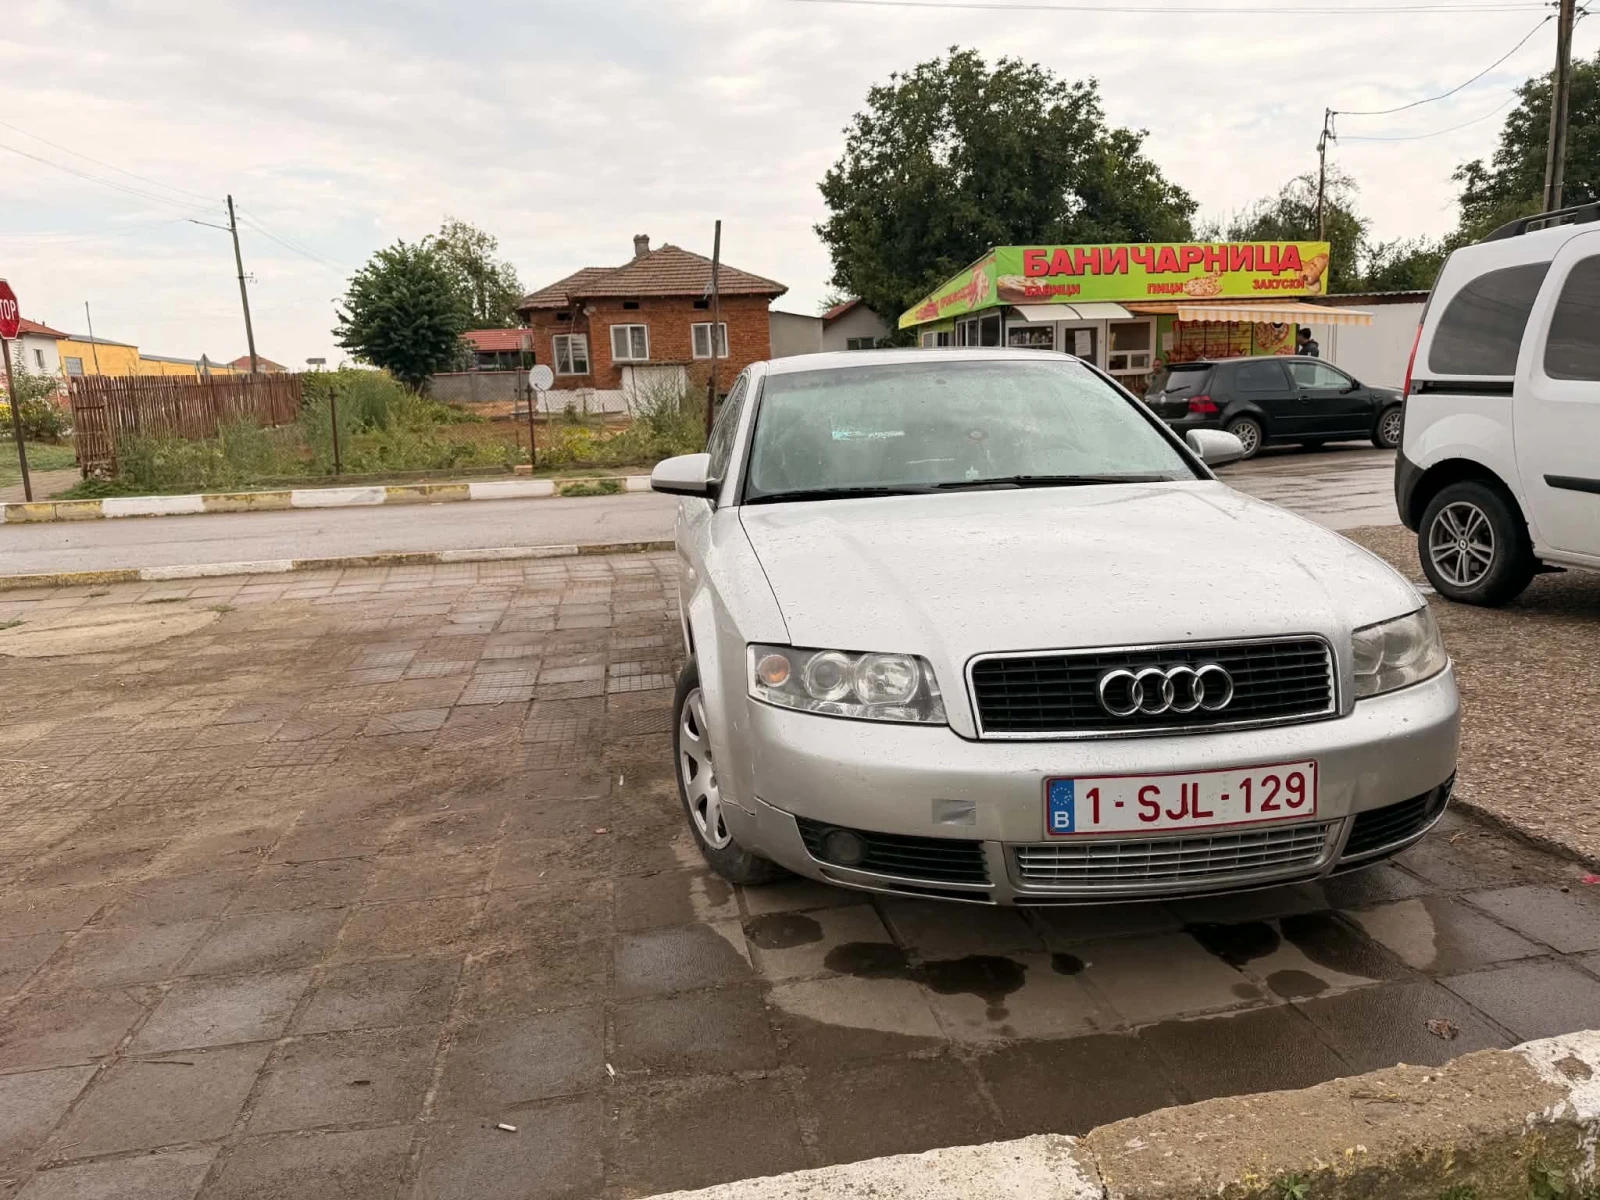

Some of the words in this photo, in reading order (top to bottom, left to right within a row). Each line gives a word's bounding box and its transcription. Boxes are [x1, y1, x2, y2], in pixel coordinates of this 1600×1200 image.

[1023, 244, 1302, 278] БАНИЧАРНИЦА
[1025, 284, 1080, 297] БАНИЦИ
[1147, 283, 1183, 295] ПИЦИ
[1253, 278, 1304, 290] ЗАКУСКИ
[0, 299, 17, 320] TOP
[1086, 772, 1305, 825] 1-SJL-129
[1054, 811, 1069, 828] B
